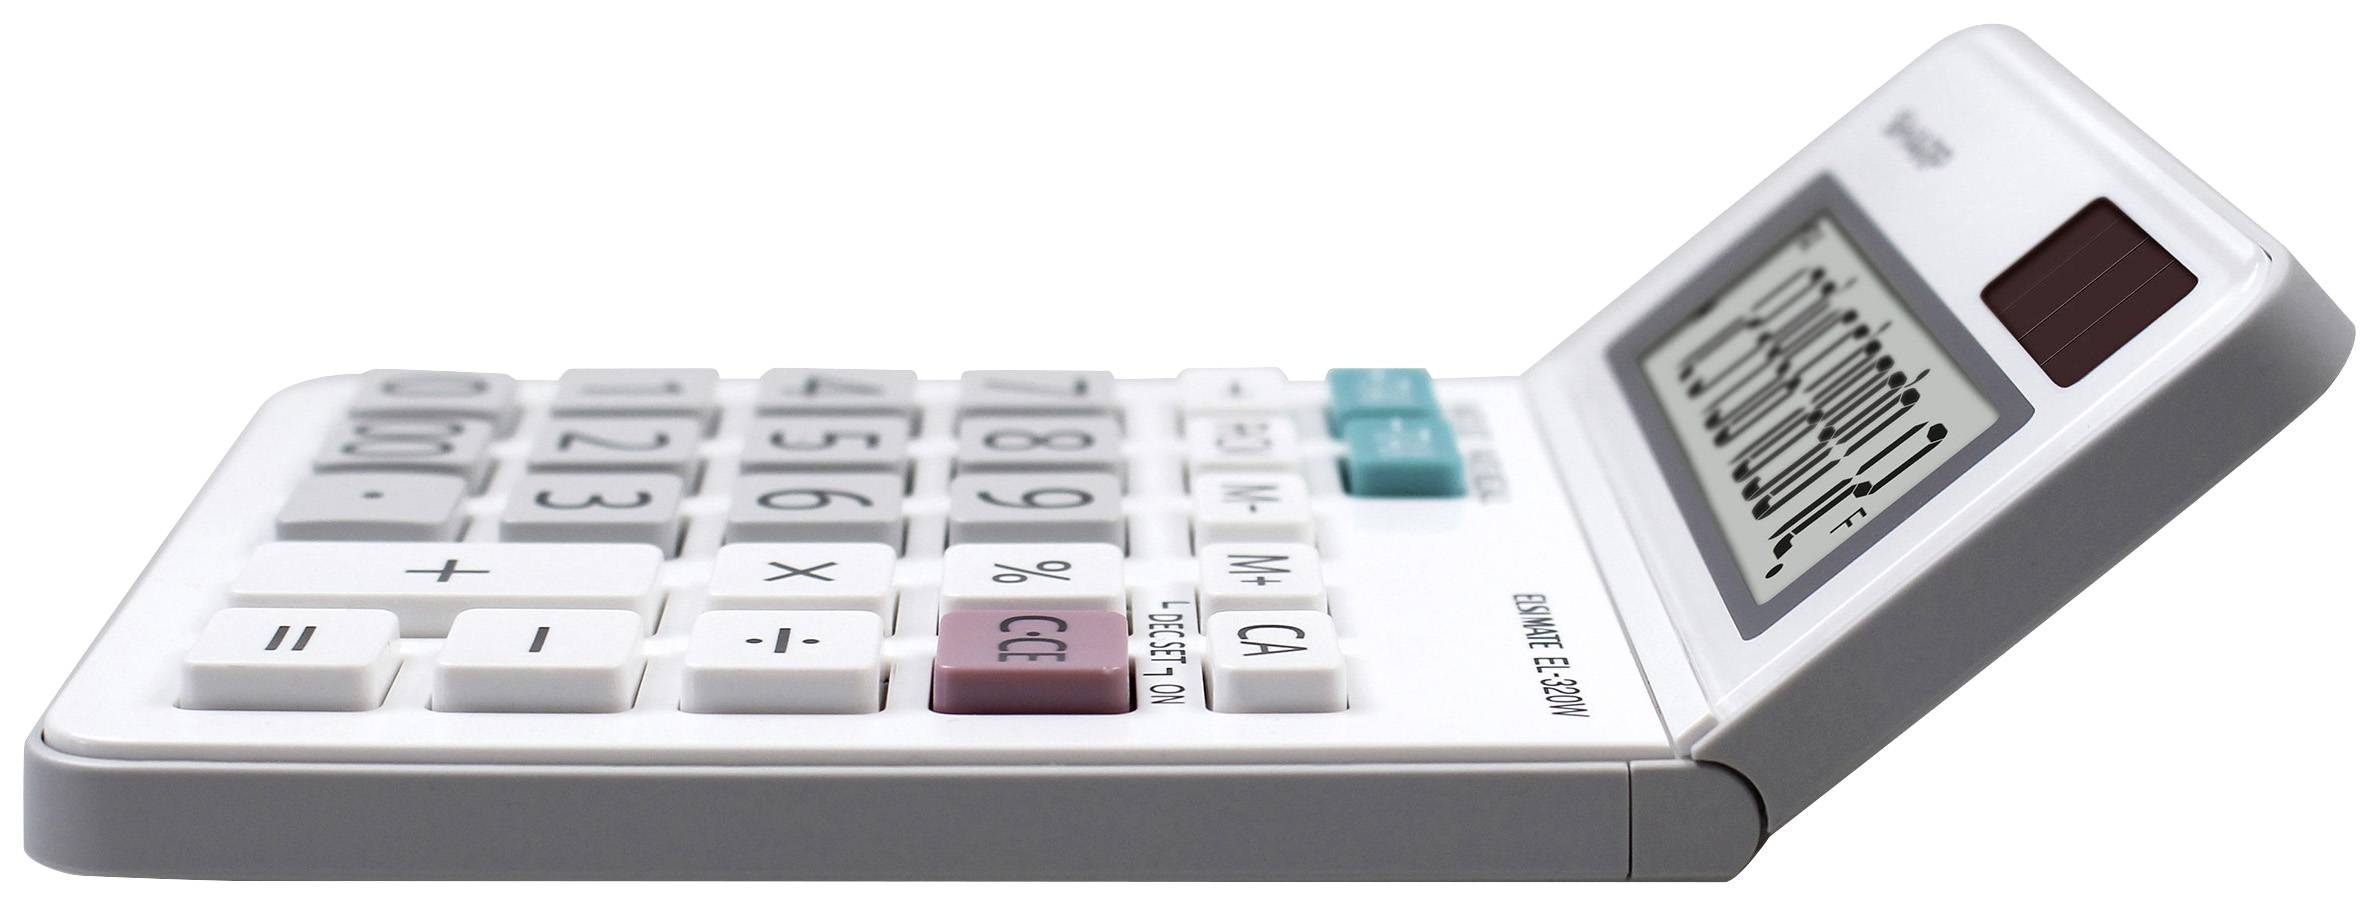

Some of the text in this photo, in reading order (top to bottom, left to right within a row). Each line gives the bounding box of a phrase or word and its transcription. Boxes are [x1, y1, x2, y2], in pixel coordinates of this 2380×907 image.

[380, 377, 490, 397] 0
[556, 430, 671, 452] 2
[768, 430, 882, 451] 5
[981, 429, 1096, 451] 8
[534, 490, 652, 510] 3
[756, 488, 874, 510] 6
[977, 488, 1095, 509] 9
[1829, 506, 1867, 534] F
[992, 561, 1071, 583] %
[1228, 555, 1291, 586] M+
[1148, 614, 1186, 664] DEC SET
[1237, 625, 1308, 656] CA
[1150, 684, 1185, 704] ON
[1533, 657, 1590, 717] EL-320W
